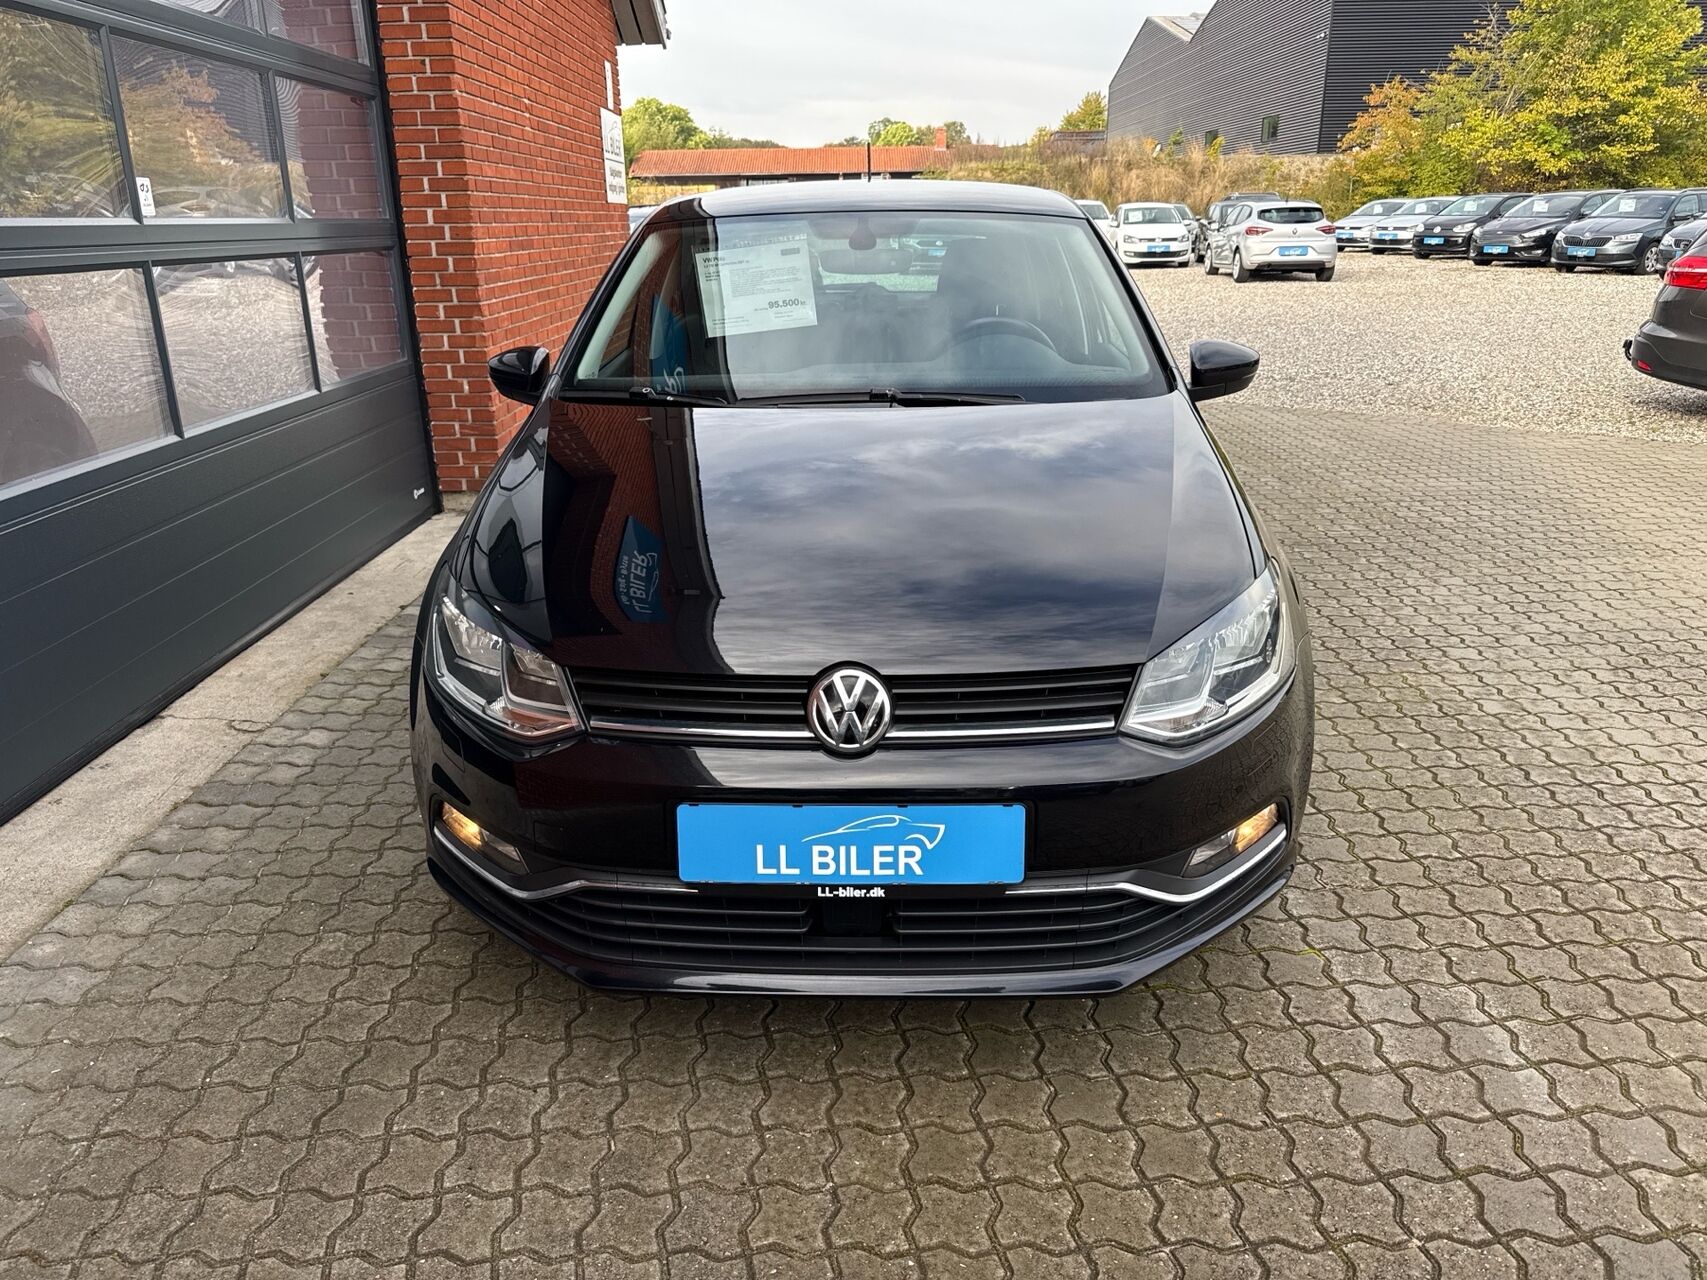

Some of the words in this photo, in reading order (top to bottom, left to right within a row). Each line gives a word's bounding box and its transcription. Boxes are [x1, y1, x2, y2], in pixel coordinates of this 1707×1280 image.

[768, 298, 800, 310] 95.500
[756, 844, 800, 875] LL
[811, 845, 924, 876] BILER
[817, 886, 886, 898] LL-biler.dk
